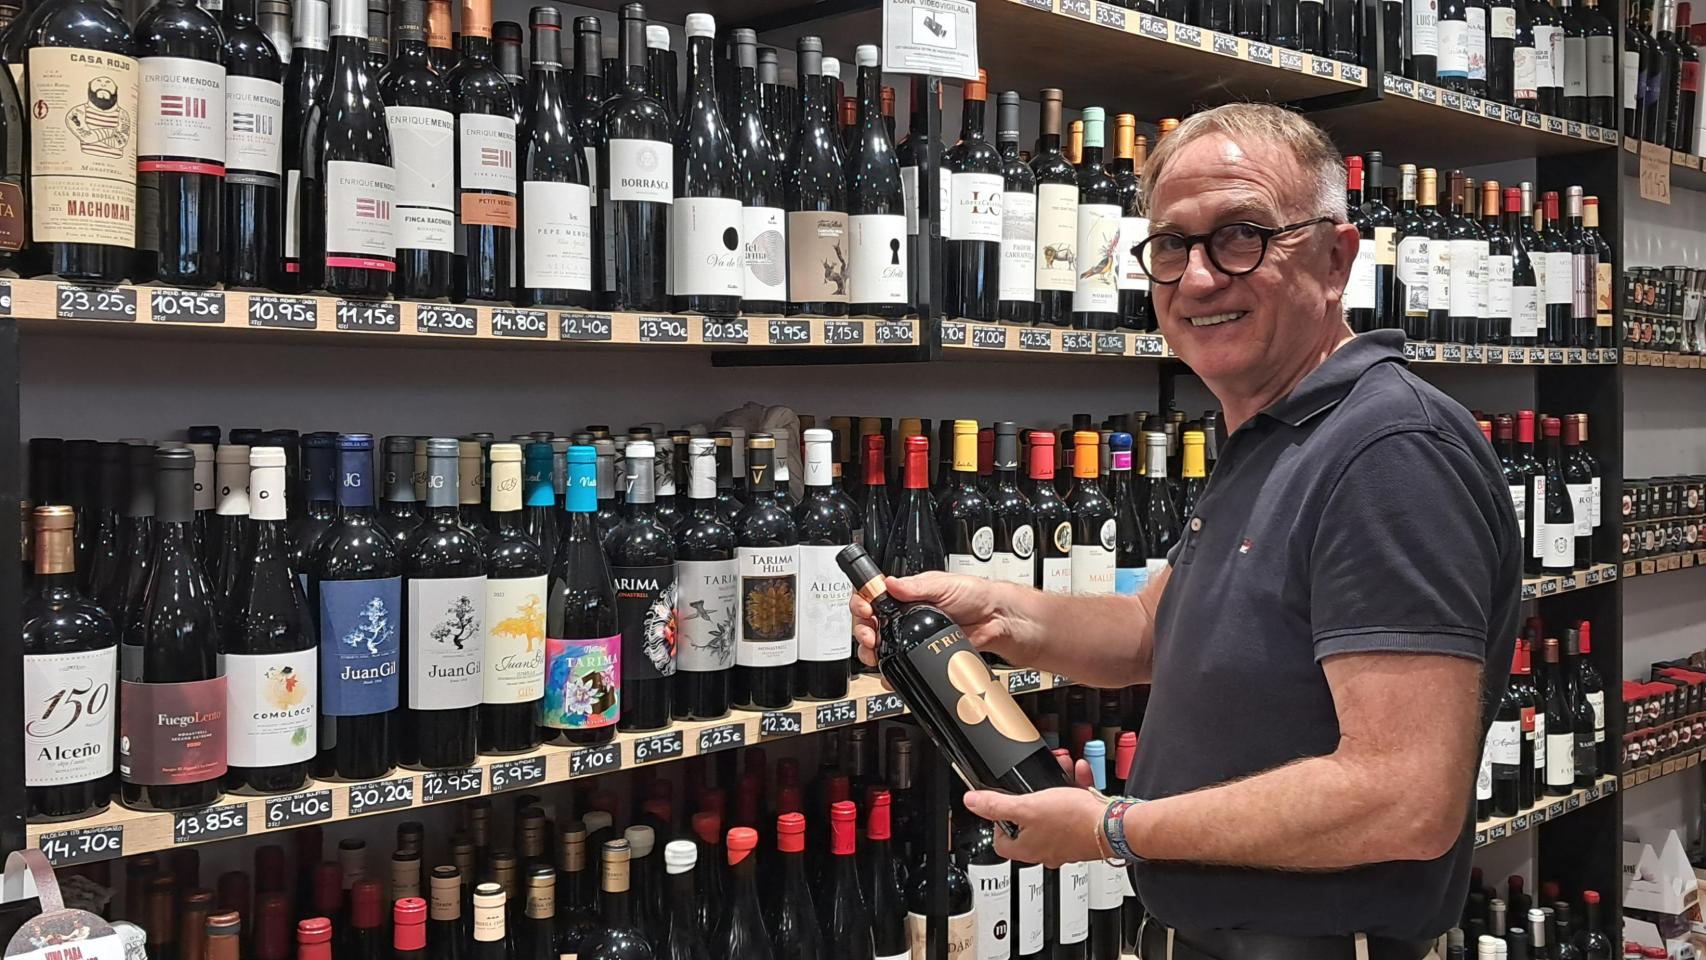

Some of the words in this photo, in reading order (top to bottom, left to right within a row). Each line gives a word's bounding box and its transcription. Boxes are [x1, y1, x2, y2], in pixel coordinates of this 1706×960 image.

[1416, 14, 1431, 25] LUIS
[70, 52, 103, 65] CASA
[106, 57, 131, 71] ROJO
[145, 74, 181, 85] ENRIQUE
[182, 75, 221, 89] MENDOZA
[226, 91, 250, 102] RIQUE
[252, 96, 281, 108] MENDOZA
[390, 115, 430, 126] ENRIQUE
[466, 128, 497, 137] ENRIQUE
[340, 177, 375, 188] ENRIQUE
[621, 178, 669, 190] BORRASCA
[67, 199, 131, 222] MACHOMAN
[405, 216, 425, 224] FINCA
[538, 228, 560, 236] PEPE
[152, 296, 220, 316] 10.95€
[249, 302, 316, 322] 10.95€
[337, 306, 396, 325] 11.15€
[418, 310, 474, 329] 12.30€
[492, 313, 546, 331] 14.80€
[561, 318, 609, 334] 12.40€
[640, 321, 688, 337] 13.90€
[769, 325, 808, 341] 9.95€
[974, 330, 1005, 343] 21.00€
[343, 472, 361, 487] JG
[428, 475, 444, 489] JG
[751, 554, 792, 565] TARIMA
[763, 564, 785, 573] HILL
[614, 578, 659, 590] ARIMA
[566, 654, 618, 668] TARIMA
[1009, 671, 1040, 690] 23.45€
[26, 677, 109, 738] 150
[253, 706, 310, 720] COMOLOCO
[38, 742, 101, 761] Alceño
[175, 810, 244, 836] 13,85€
[42, 833, 120, 860] 14.70€
[63, 946, 83, 960] PARA
